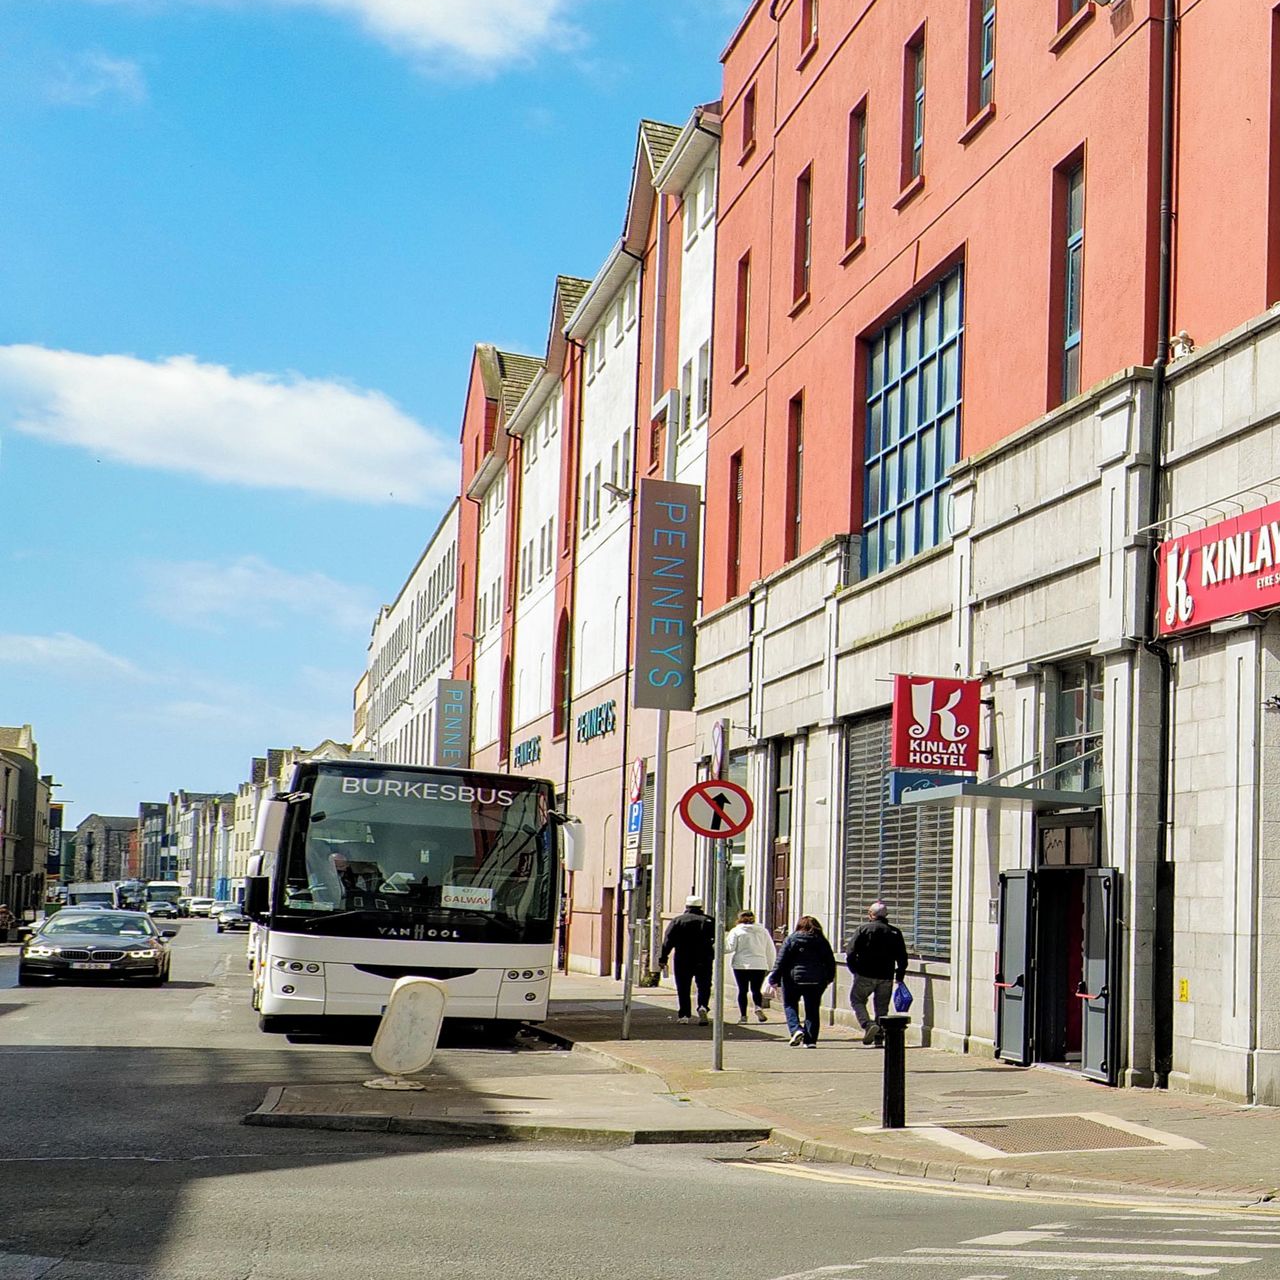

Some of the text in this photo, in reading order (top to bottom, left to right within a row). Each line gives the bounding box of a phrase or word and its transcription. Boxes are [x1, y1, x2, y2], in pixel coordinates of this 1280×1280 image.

[1256, 572, 1275, 590] EYRE
[649, 501, 688, 688] PENNEYS
[909, 739, 967, 755] KINLAY
[909, 752, 967, 767] HOSTEL
[342, 777, 514, 807] BURKESBUS
[632, 805, 639, 819] P
[443, 895, 490, 905] GALWAY
[378, 924, 461, 940] VAN HOOL
